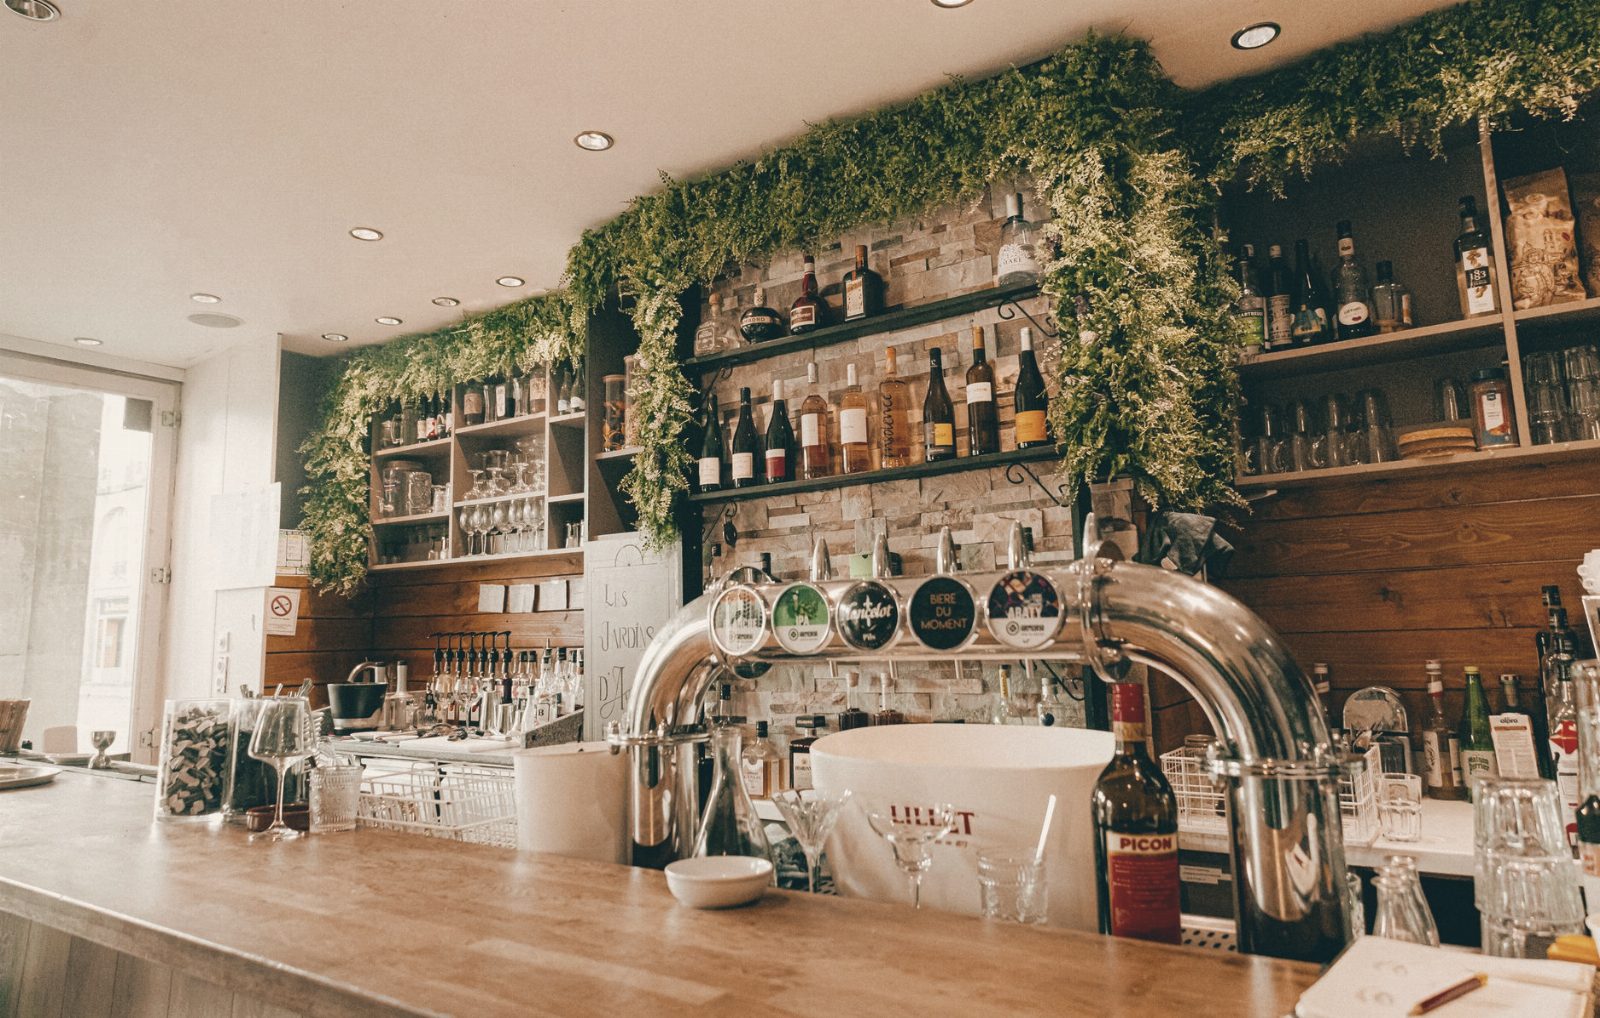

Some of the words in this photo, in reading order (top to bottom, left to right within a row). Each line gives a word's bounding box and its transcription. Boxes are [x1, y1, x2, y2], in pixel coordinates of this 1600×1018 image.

[935, 606, 952, 617] DU
[920, 618, 967, 630] MOMENT
[1120, 837, 1172, 852] PICON
